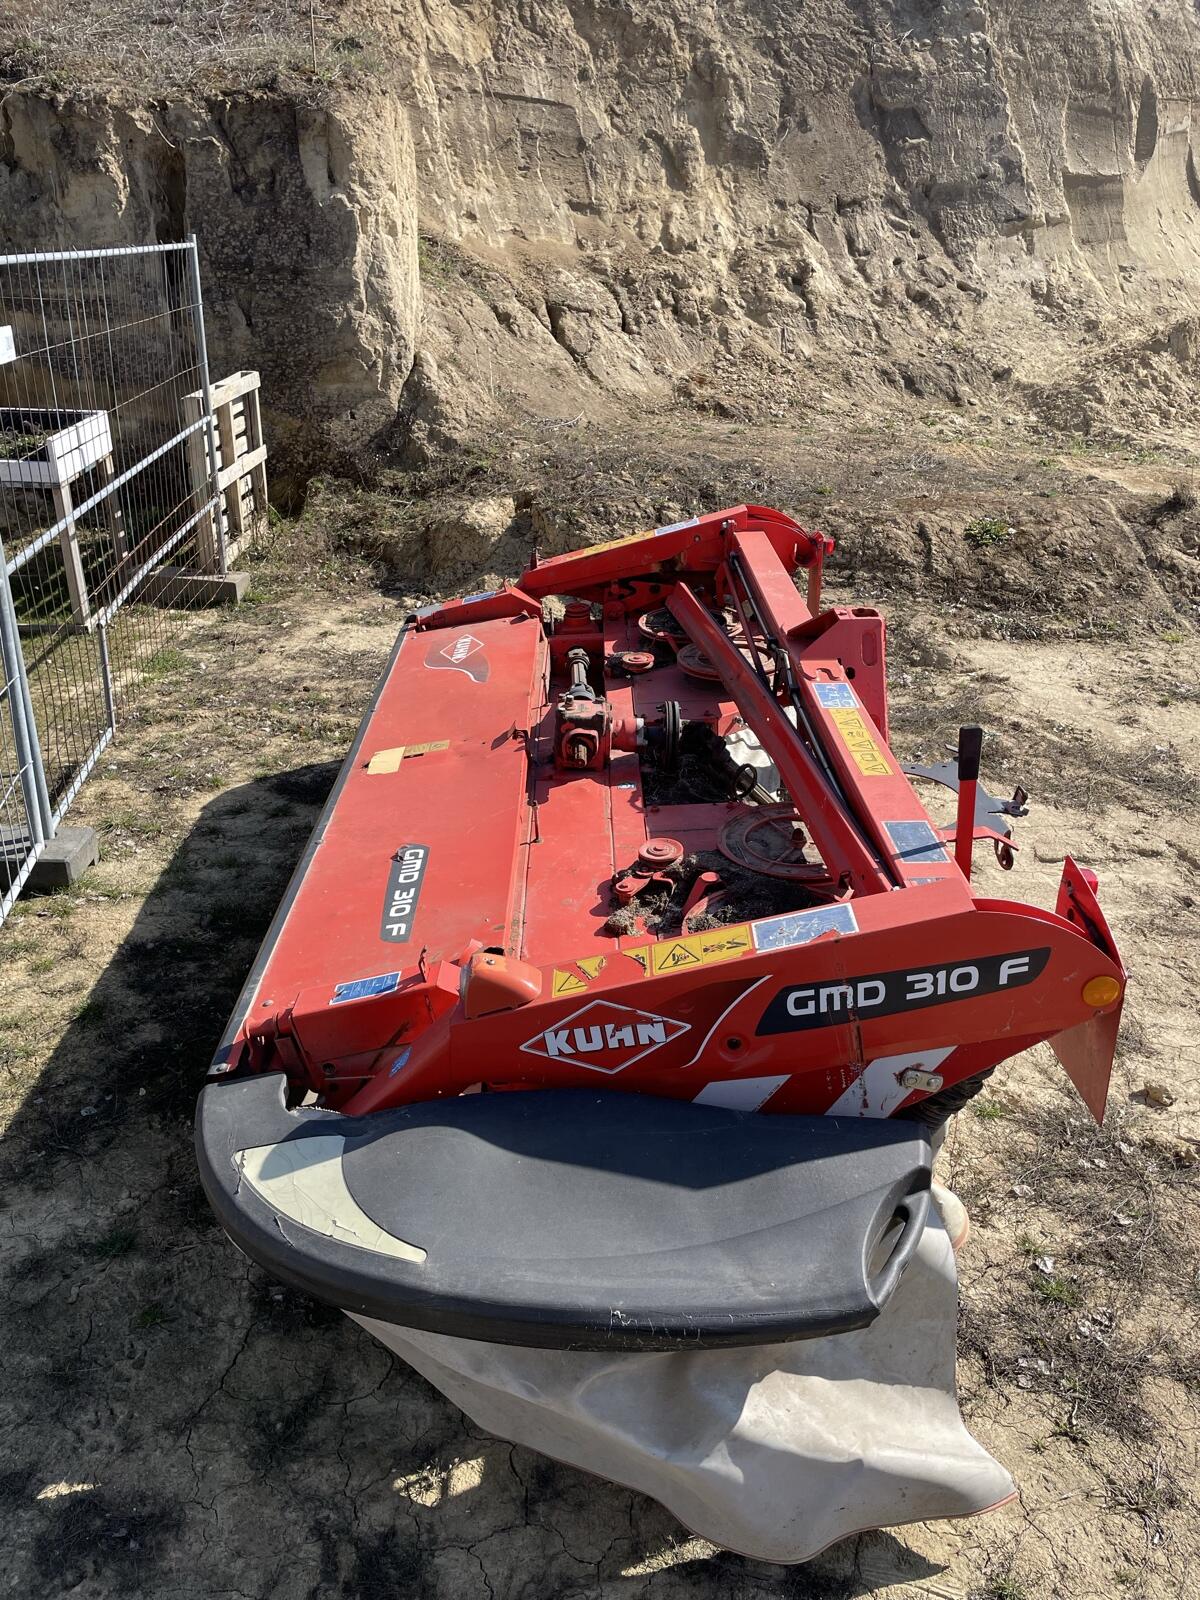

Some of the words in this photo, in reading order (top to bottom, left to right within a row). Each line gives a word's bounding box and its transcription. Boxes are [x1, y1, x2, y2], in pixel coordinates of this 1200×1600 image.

[398, 849, 424, 883] GMD
[389, 888, 415, 917] 310
[386, 923, 406, 936] F
[787, 980, 886, 1017] GMD
[906, 965, 979, 1000] 310
[999, 956, 1030, 985] F
[543, 1017, 667, 1056] KUHN
